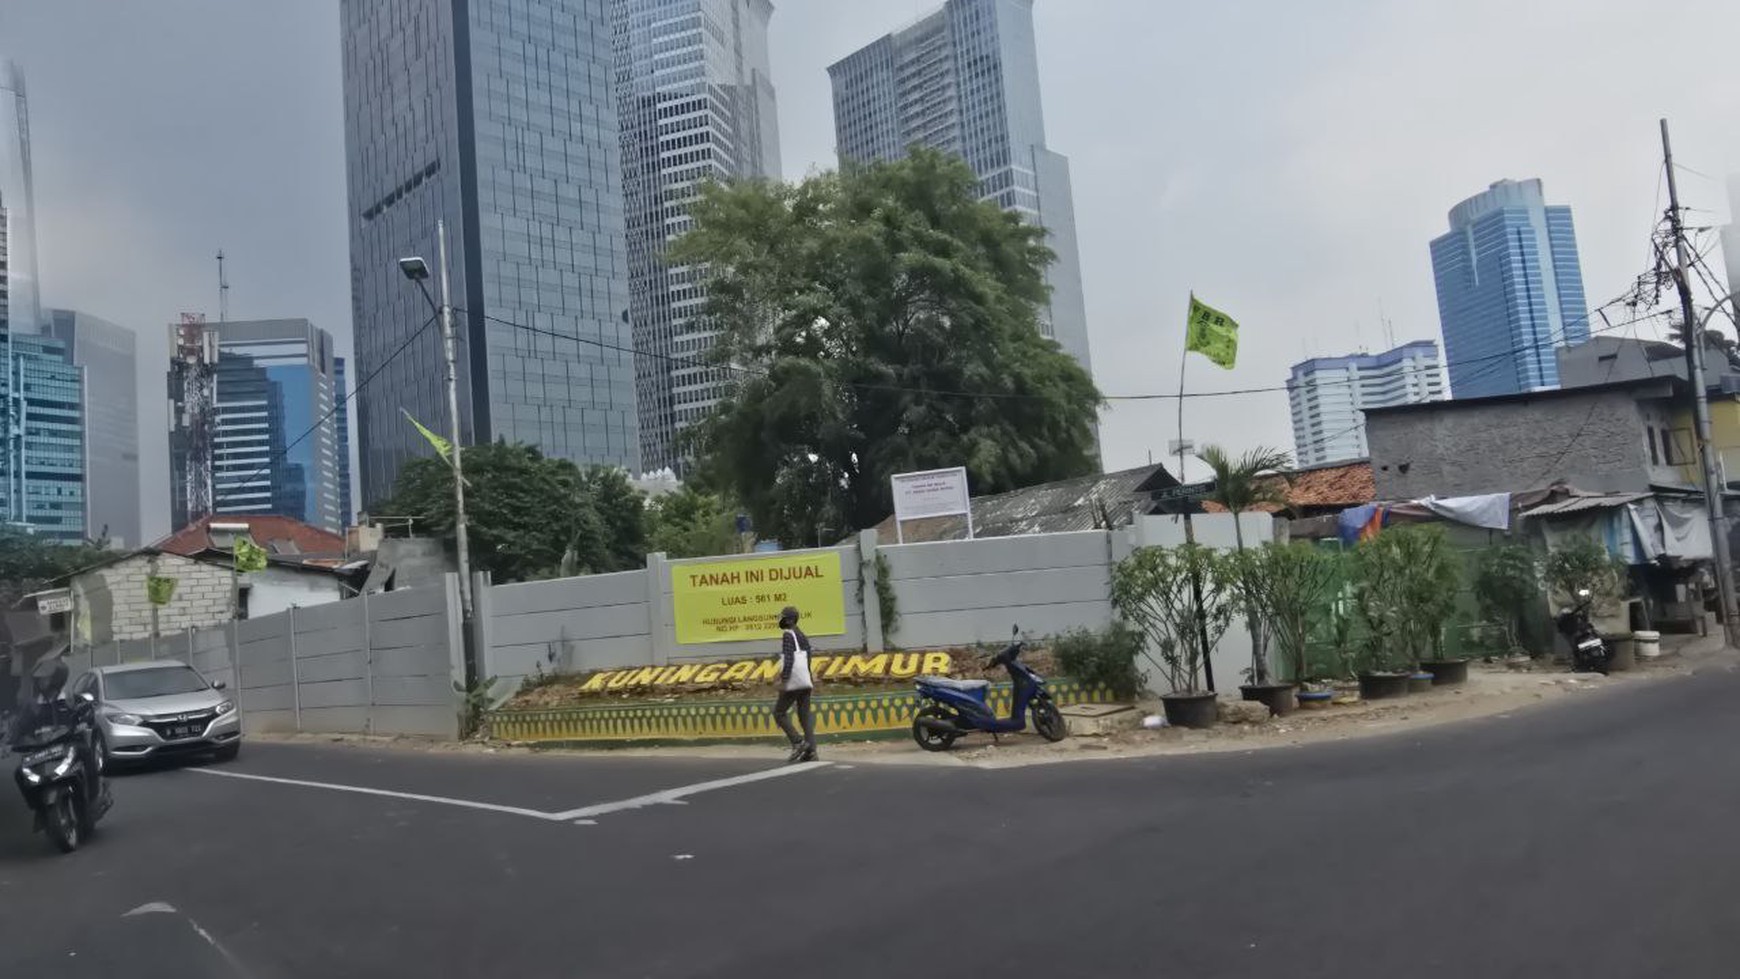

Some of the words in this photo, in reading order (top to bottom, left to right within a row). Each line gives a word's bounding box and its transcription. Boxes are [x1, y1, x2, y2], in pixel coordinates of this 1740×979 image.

[690, 572, 740, 587] TANAH
[745, 569, 764, 584] INI
[768, 566, 824, 581] DIJUAL
[721, 595, 747, 606] LUAS
[774, 592, 787, 603] M2
[580, 660, 783, 690] KUNINGAN
[810, 651, 951, 679] TIMUR
